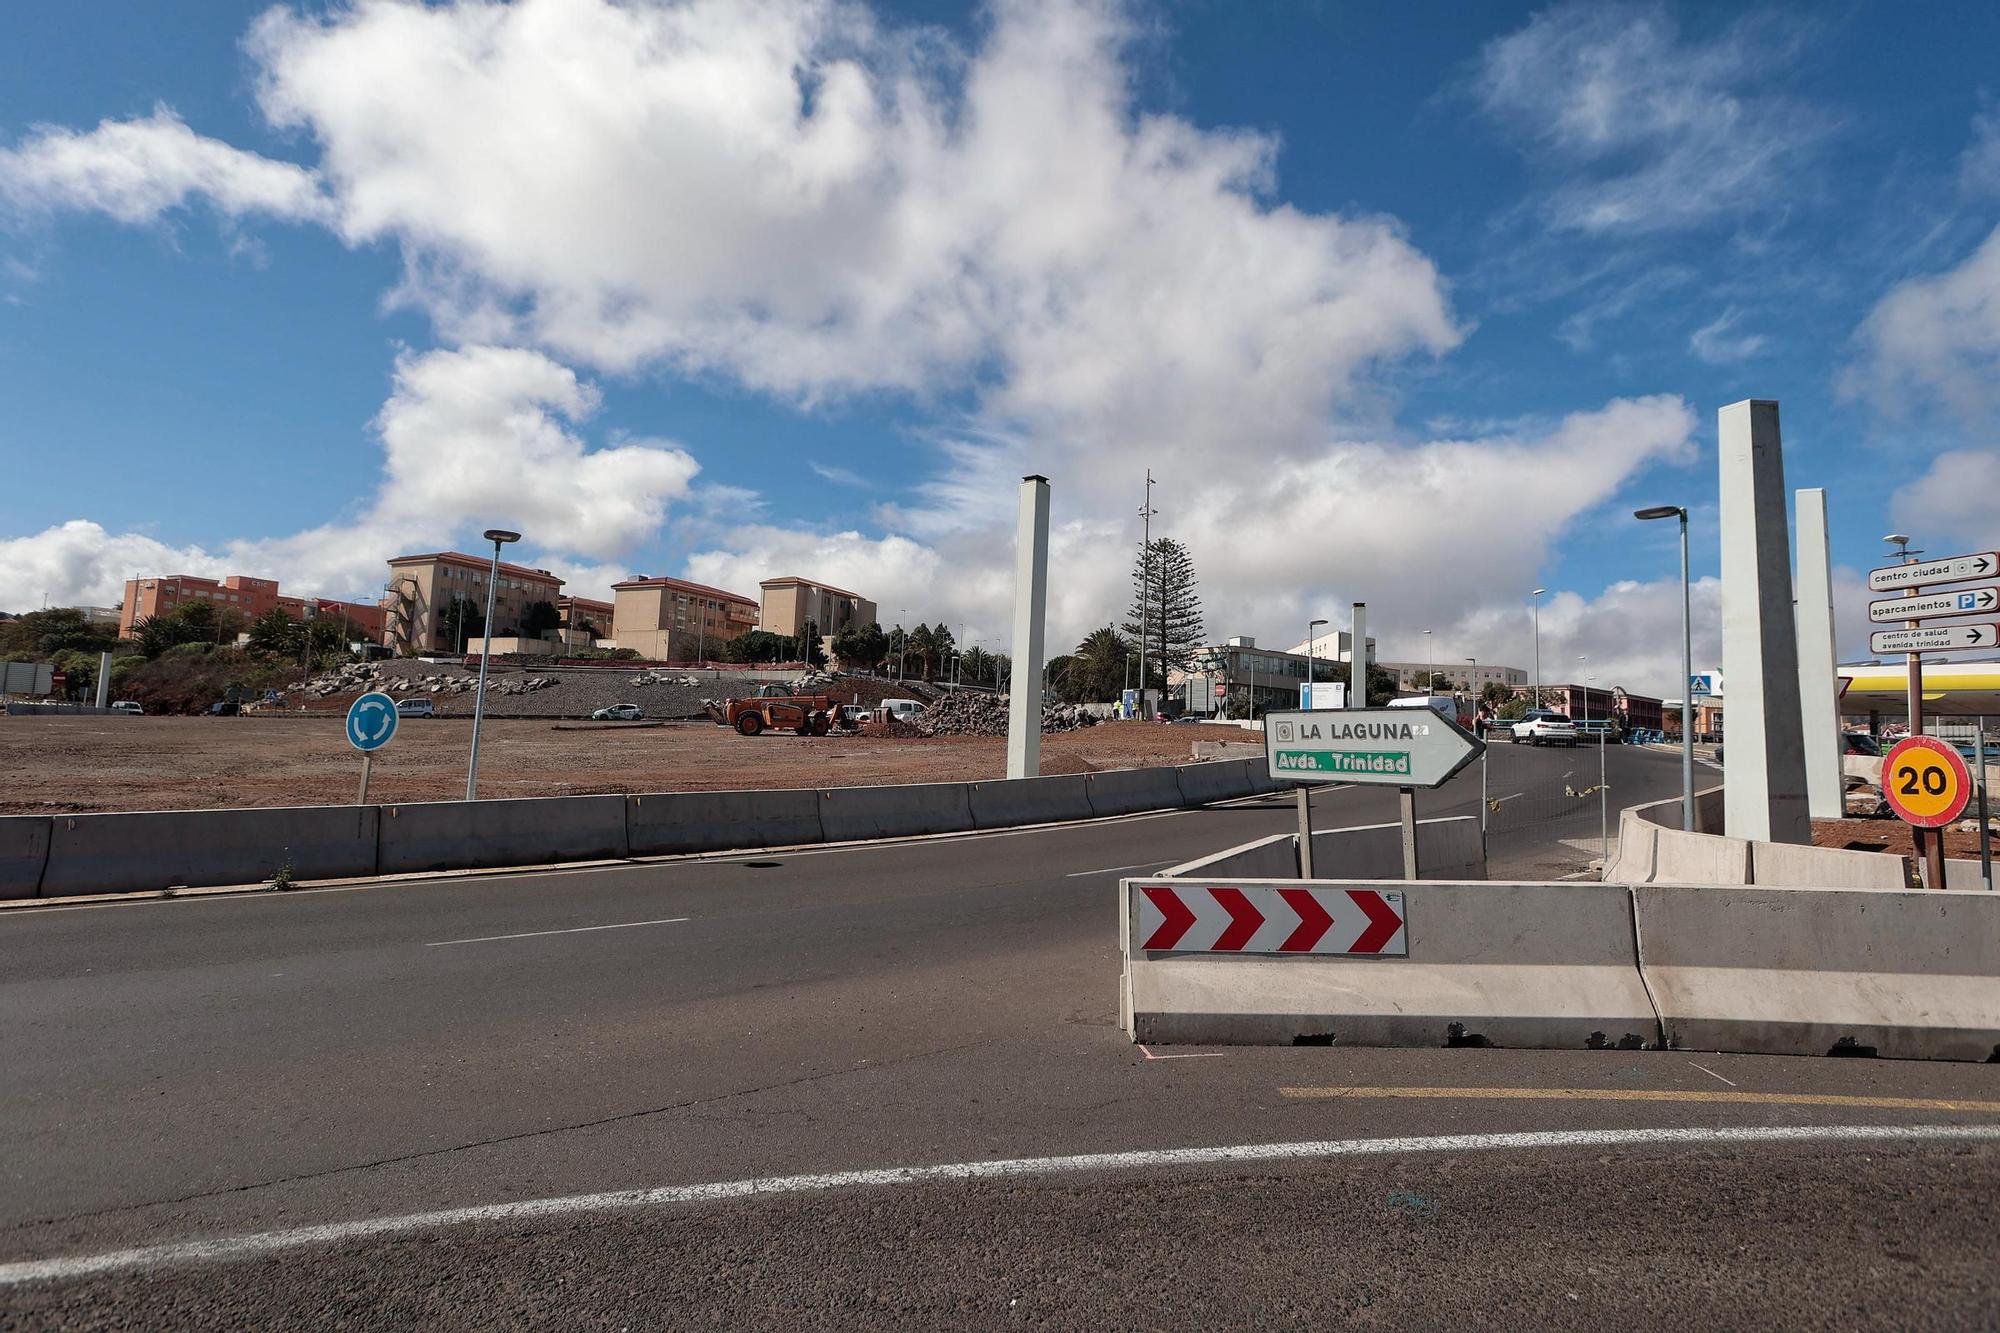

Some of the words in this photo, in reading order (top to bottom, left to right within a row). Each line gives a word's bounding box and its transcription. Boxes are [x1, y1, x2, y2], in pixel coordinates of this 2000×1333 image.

[1874, 572, 1908, 583] centro
[1912, 565, 1950, 577] ciudad
[1872, 601, 1951, 616] aparcamientos
[1924, 629, 1948, 637] salud
[1882, 642, 1913, 650] avenida
[1916, 639, 1951, 648] trinidad
[1300, 724, 1321, 739] LA
[1331, 723, 1414, 740] LAGUNA
[1277, 752, 1323, 770] Avda.
[1331, 753, 1408, 773] Trinidad
[1898, 766, 1947, 795] 20
